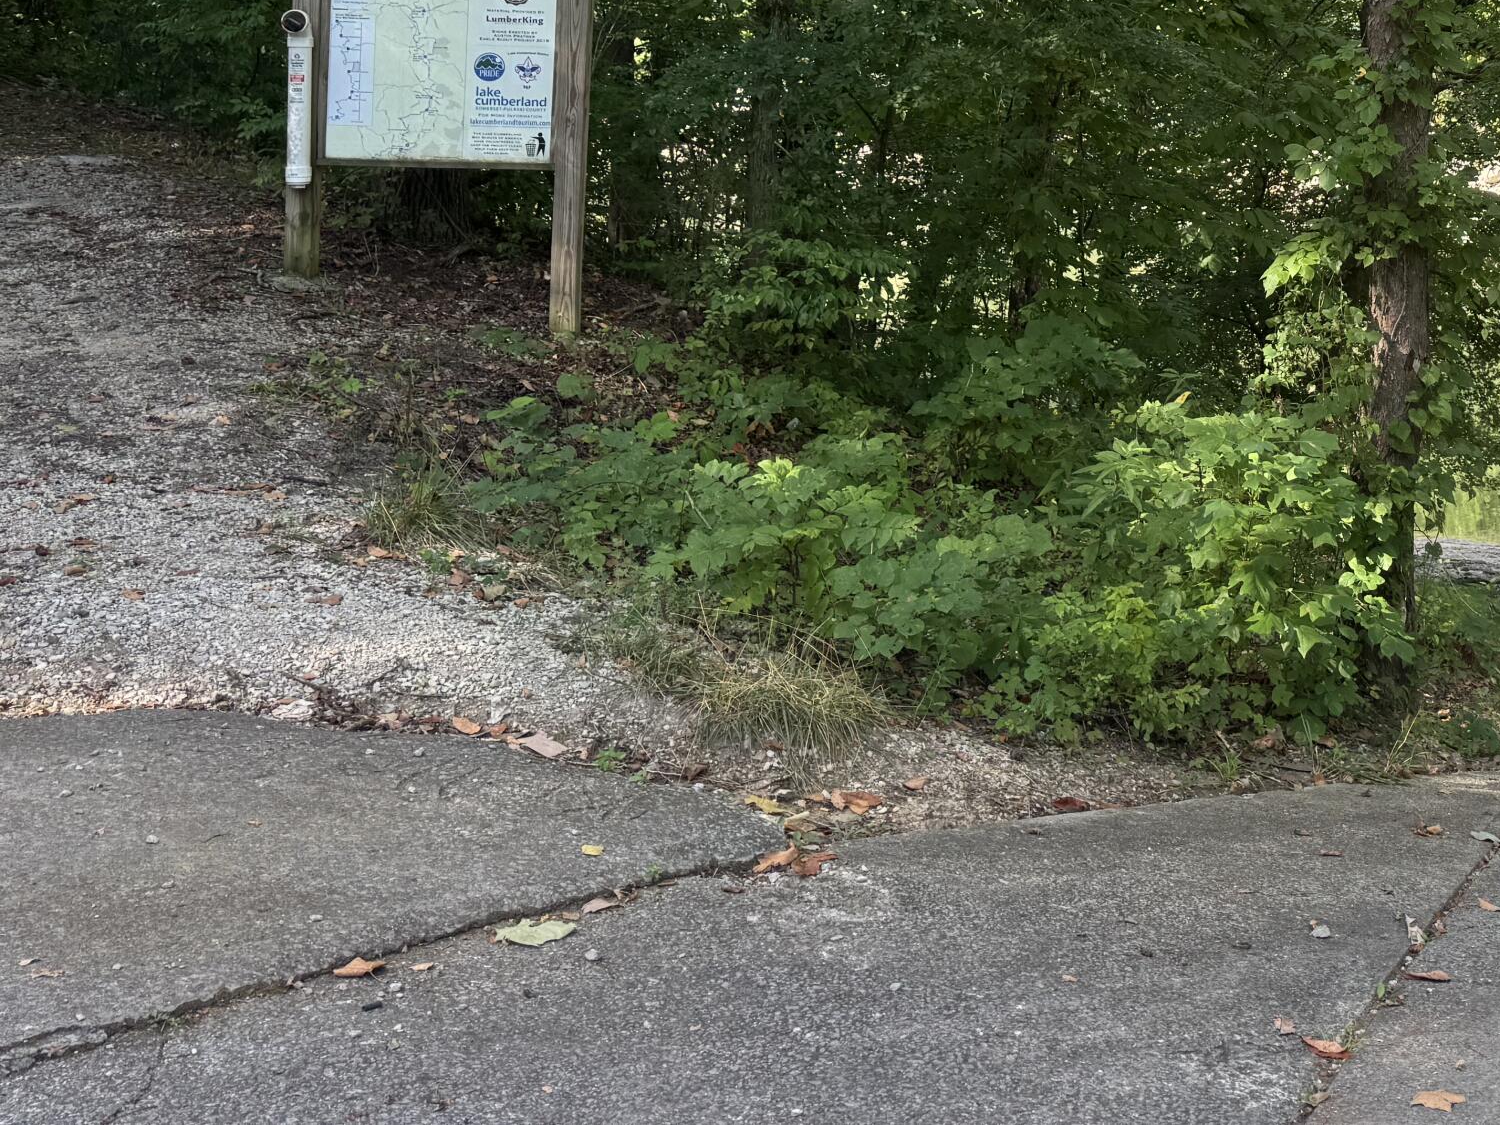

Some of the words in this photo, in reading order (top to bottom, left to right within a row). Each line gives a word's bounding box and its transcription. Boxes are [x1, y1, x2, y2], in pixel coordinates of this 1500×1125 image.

[486, 15, 544, 26] LumberKing
[480, 69, 499, 77] PRIDE
[476, 86, 501, 97] lake
[475, 96, 547, 106] cumberland
